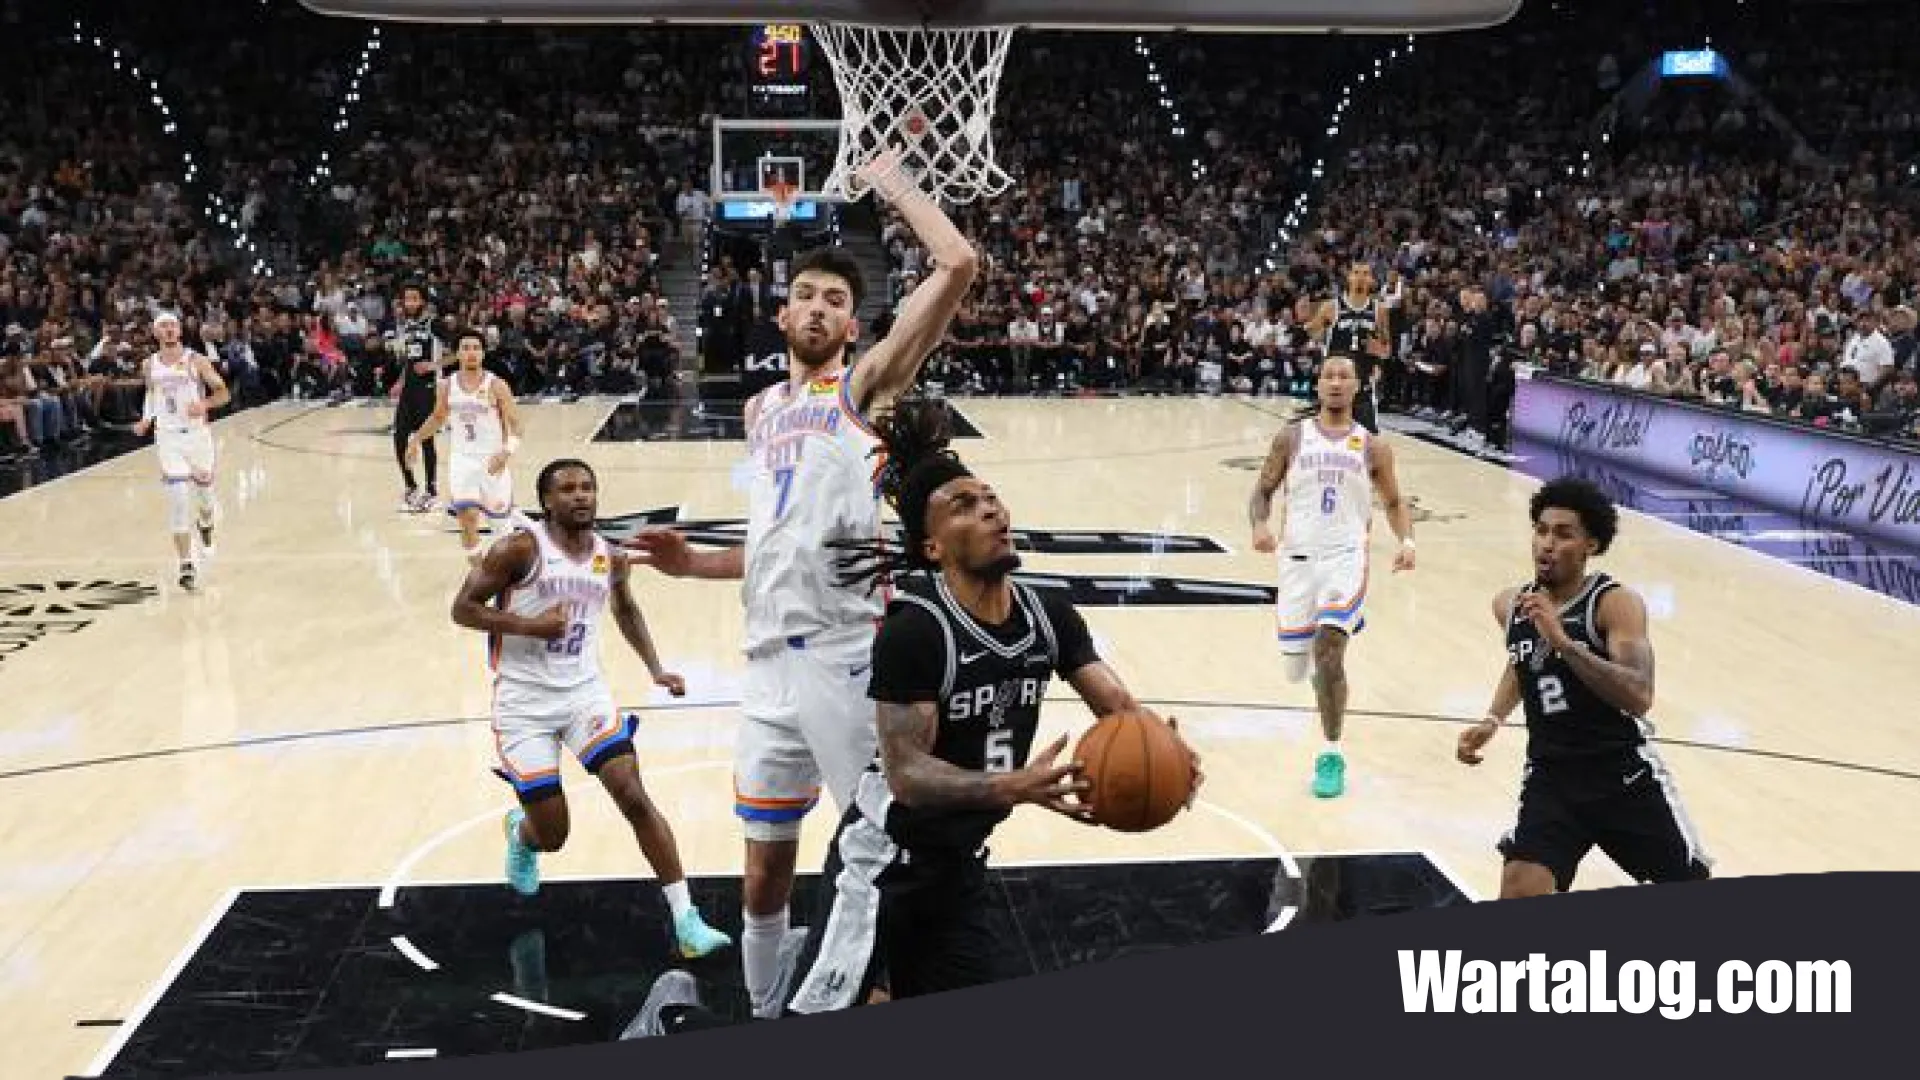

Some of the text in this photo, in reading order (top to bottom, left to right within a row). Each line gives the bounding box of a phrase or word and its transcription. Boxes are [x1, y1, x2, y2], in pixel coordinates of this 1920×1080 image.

[774, 467, 795, 520] 7
[1321, 487, 1336, 514] 6
[1537, 676, 1569, 715] 2
[985, 729, 1014, 773] 5
